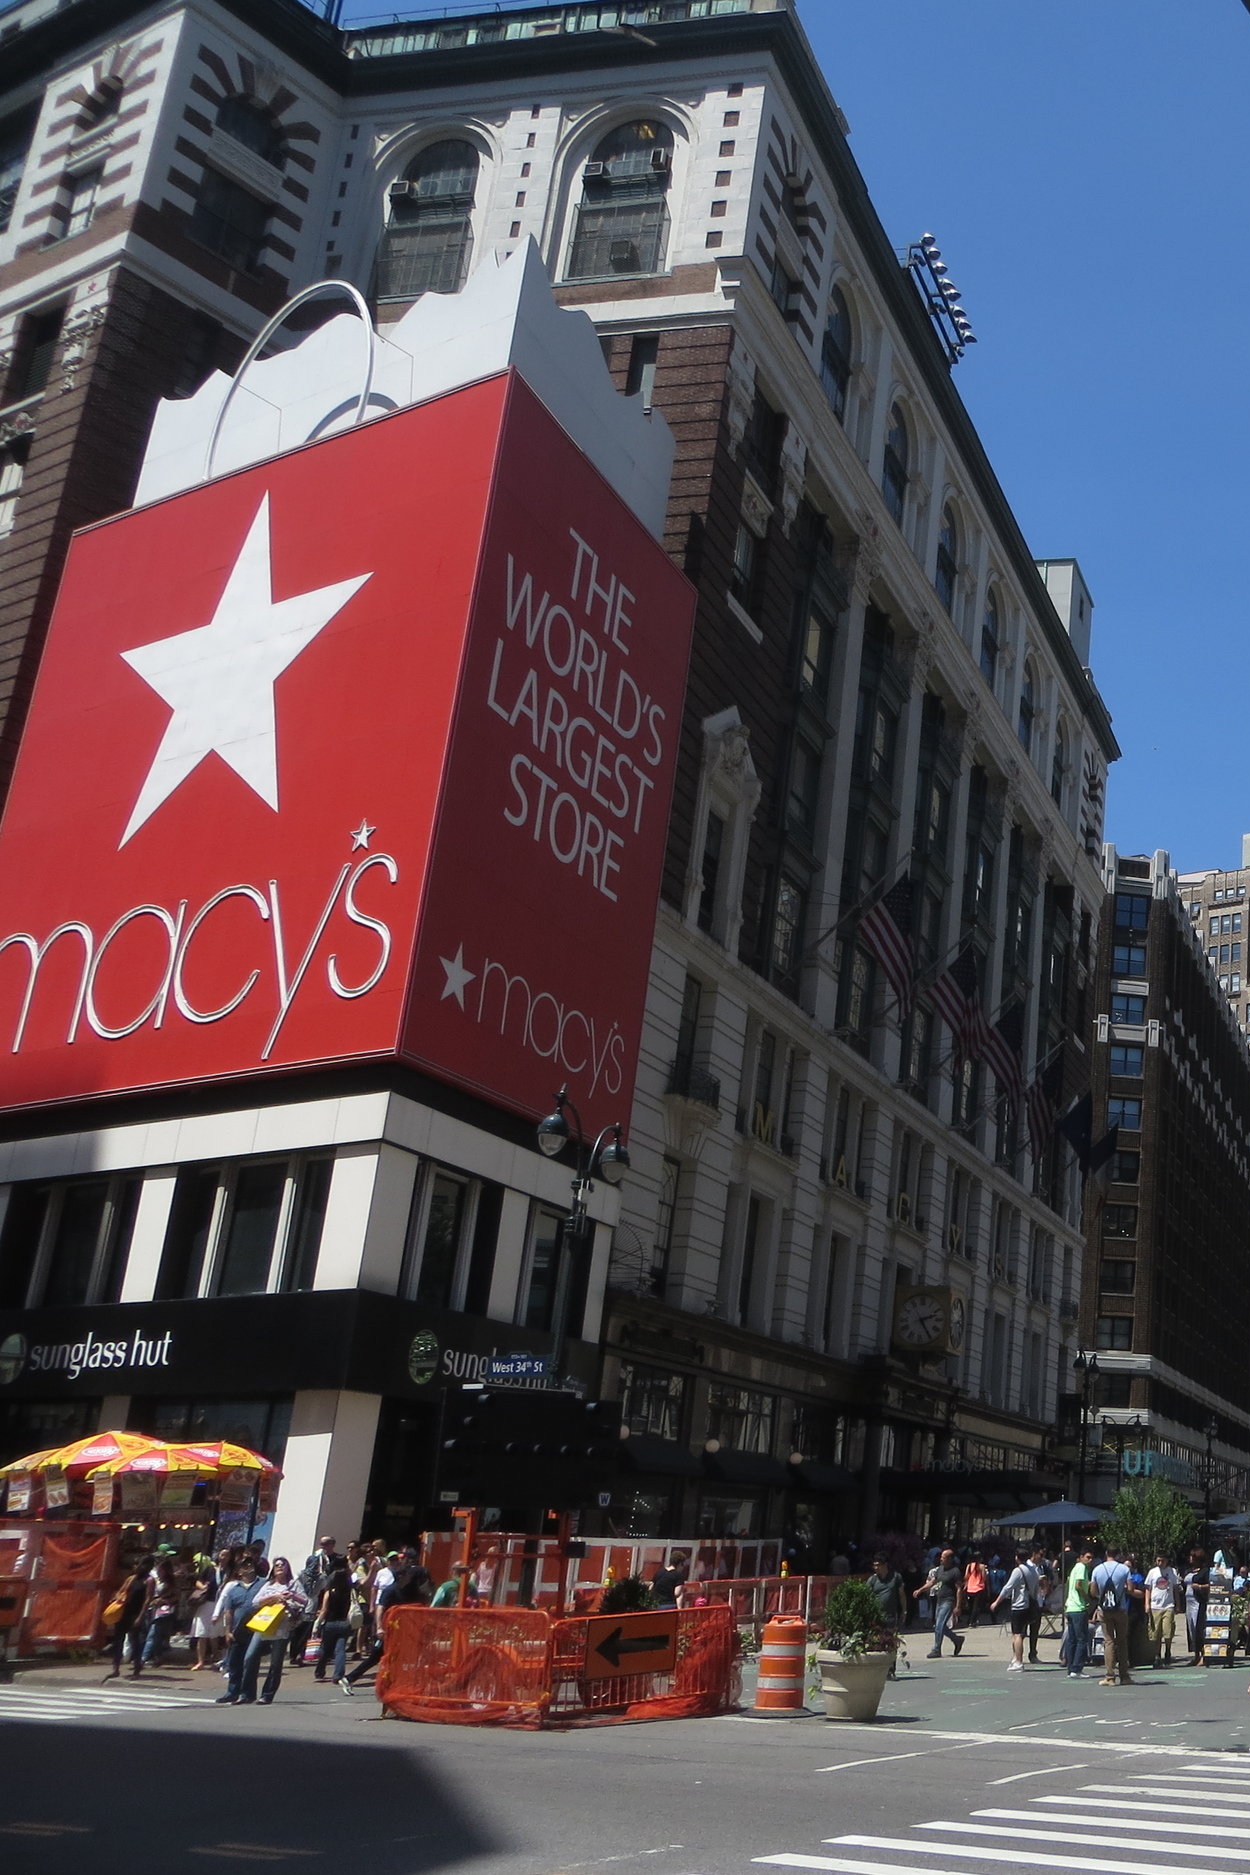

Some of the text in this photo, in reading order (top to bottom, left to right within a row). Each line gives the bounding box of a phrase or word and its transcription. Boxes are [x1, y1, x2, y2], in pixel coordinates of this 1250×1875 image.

[506, 552, 666, 766] WORLD'S
[568, 527, 636, 656] THE
[487, 637, 654, 834] LARGEST
[503, 753, 625, 902] STORE
[29, 1329, 173, 1380] sunglass hut
[492, 1360, 543, 1373] West 34th St
